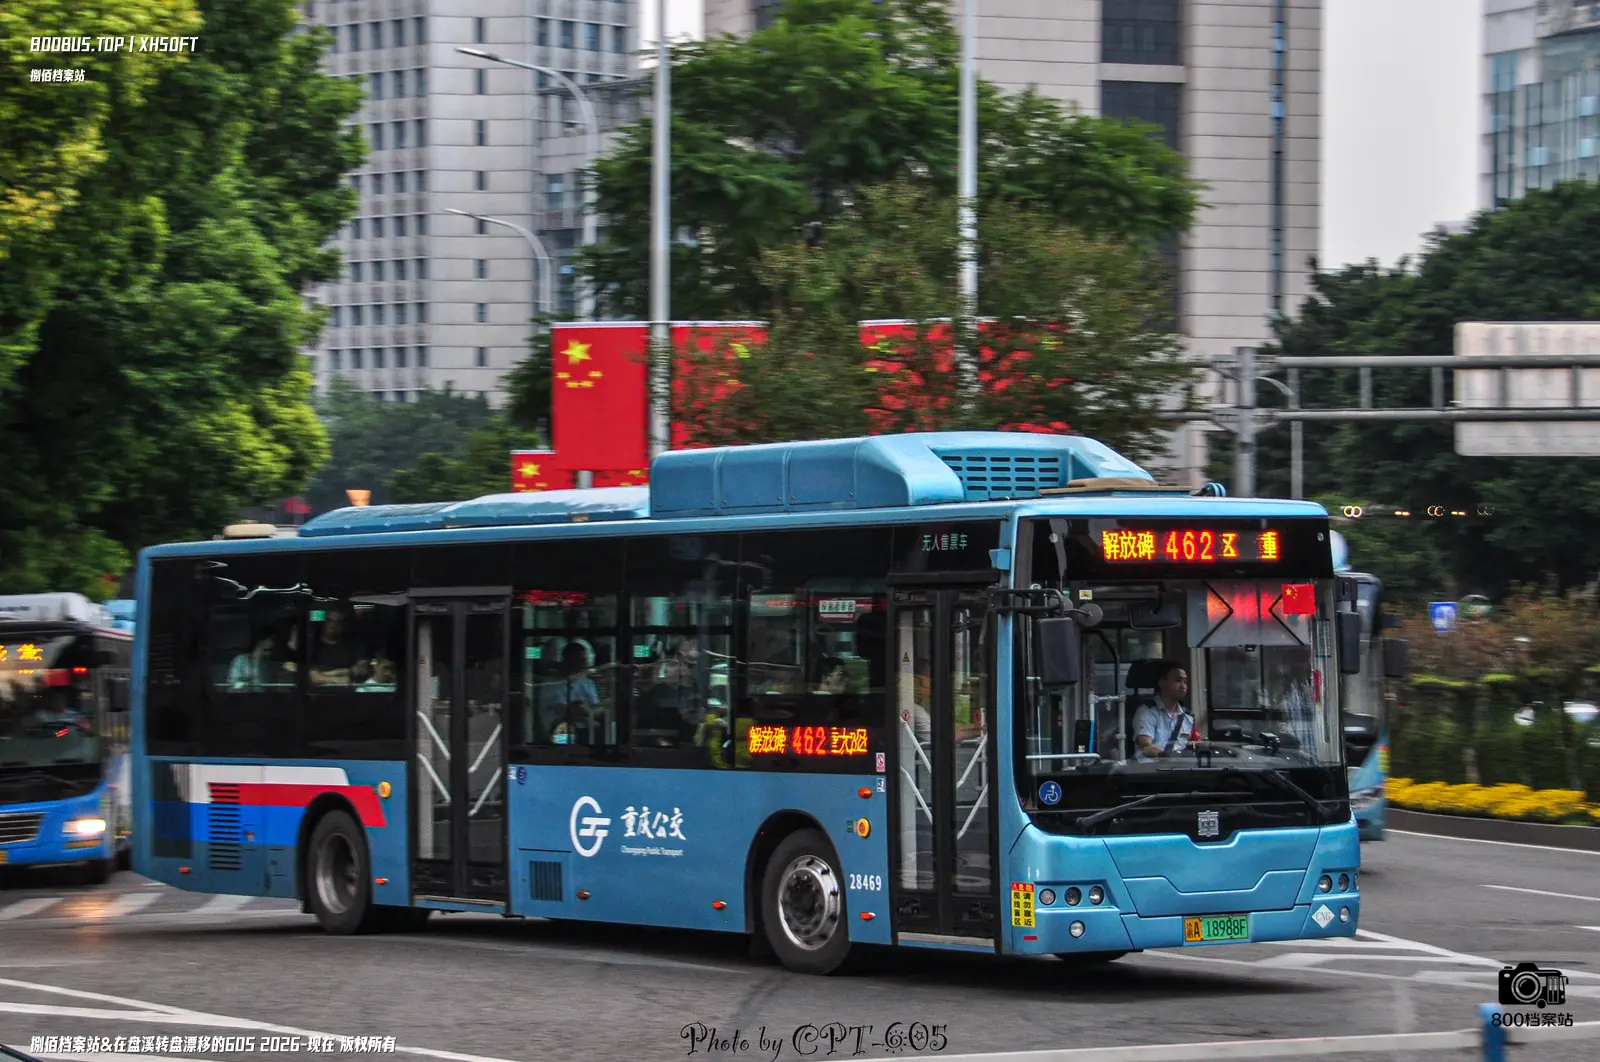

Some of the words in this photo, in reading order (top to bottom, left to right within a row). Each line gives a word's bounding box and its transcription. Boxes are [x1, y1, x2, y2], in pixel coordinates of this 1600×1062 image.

[922, 533, 968, 551] 无人售票车
[1102, 530, 1155, 561] 解放碑
[1165, 530, 1214, 561] 462
[1260, 531, 1279, 560] 重
[748, 726, 787, 754] 解放碑
[792, 726, 827, 755] 462
[620, 806, 687, 840] 重庆公交
[849, 873, 882, 891] 28469
[1315, 911, 1332, 922] CNG
